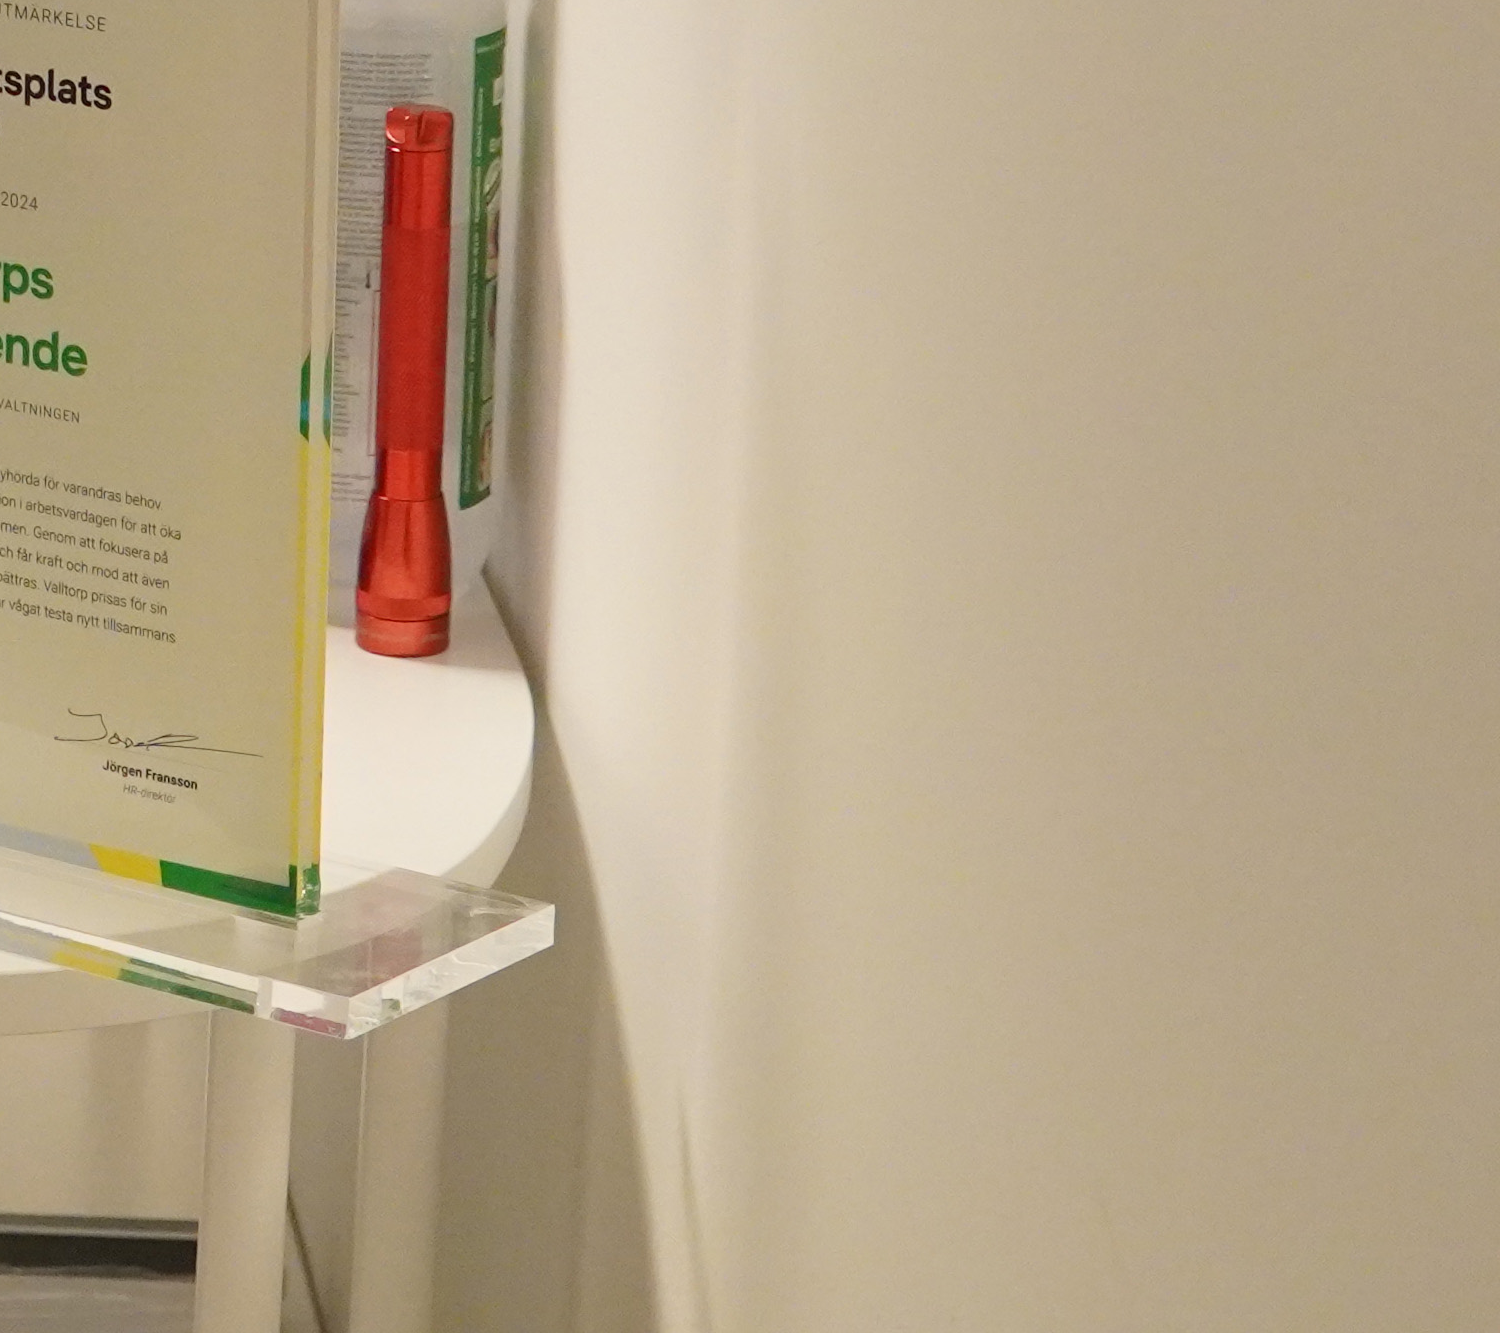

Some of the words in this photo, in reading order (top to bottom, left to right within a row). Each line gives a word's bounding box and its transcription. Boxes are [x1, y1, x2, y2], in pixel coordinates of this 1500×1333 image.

[0, 190, 38, 210] 2024
[43, 474, 59, 490] för
[62, 482, 121, 502] varandras
[25, 500, 117, 528] arbetsvardagen
[120, 515, 137, 531] för
[140, 522, 156, 536] att
[159, 524, 181, 540] öka
[33, 525, 75, 545] Genom
[79, 536, 95, 549] att
[98, 537, 150, 560] fokusera
[153, 549, 168, 564] på
[16, 546, 32, 562] får
[35, 550, 63, 568] kraft
[65, 559, 88, 573] och
[91, 565, 118, 580] mod
[121, 571, 138, 584] att
[141, 575, 169, 589] även
[43, 579, 88, 601] Valltorp
[90, 591, 126, 607] prisas
[129, 595, 146, 612] för
[149, 601, 167, 616] sin
[8, 598, 40, 617] vågat
[43, 605, 73, 622] testa
[76, 614, 99, 628] nytt
[102, 617, 176, 644] tillsammans
[102, 759, 142, 777] Jörgen
[145, 768, 197, 790] Fransson
